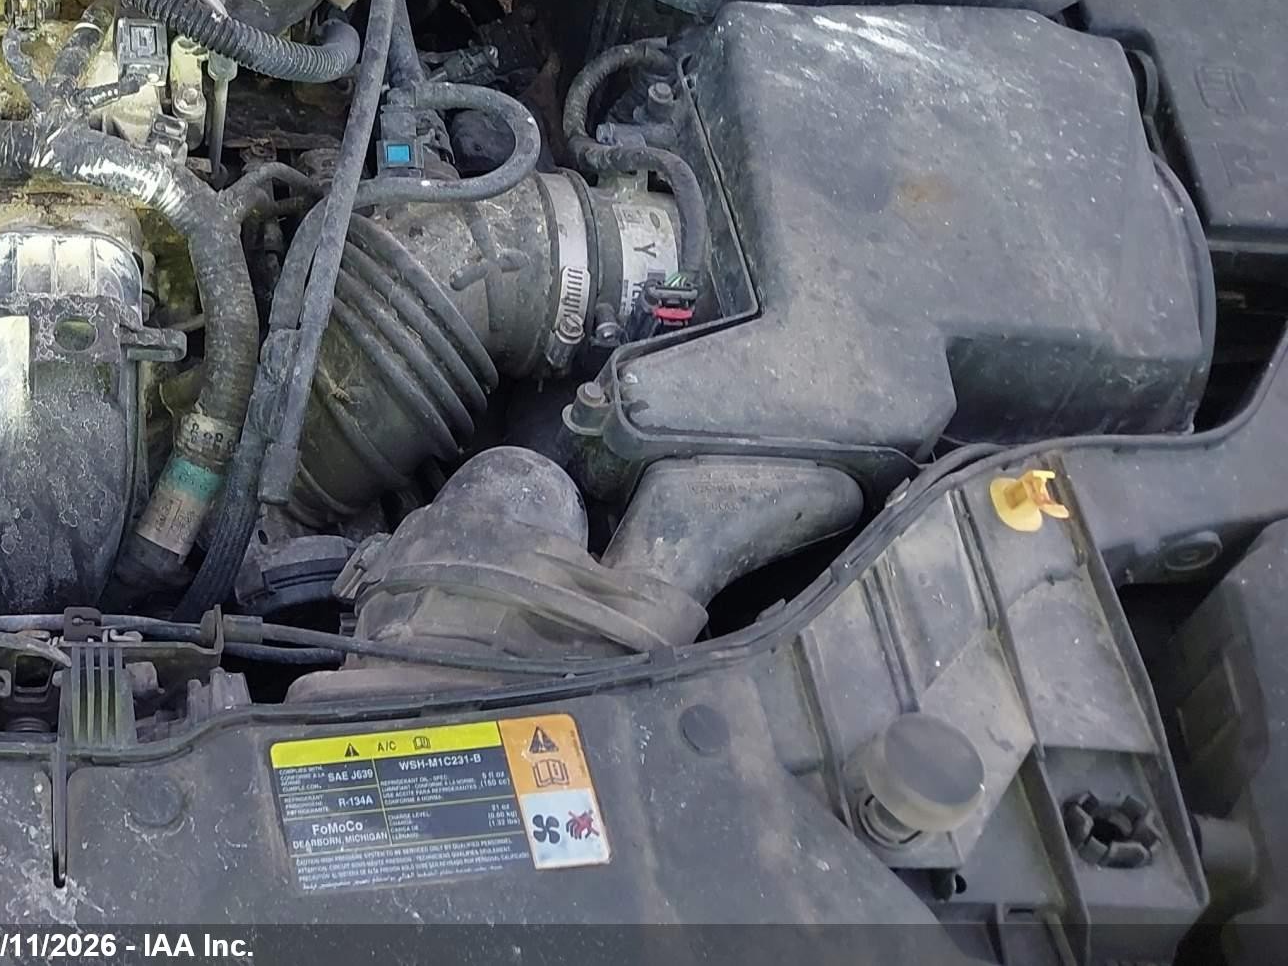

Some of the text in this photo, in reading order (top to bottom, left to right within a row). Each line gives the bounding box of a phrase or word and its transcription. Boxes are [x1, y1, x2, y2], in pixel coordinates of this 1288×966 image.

[632, 241, 658, 259] Y
[376, 740, 397, 753] A/C
[398, 752, 483, 772] WSH-M1C231-B
[327, 768, 374, 783] SAE J639
[338, 794, 374, 808] R-134A
[312, 819, 364, 837] FoMoCo
[344, 831, 389, 844] MICHIGAN
